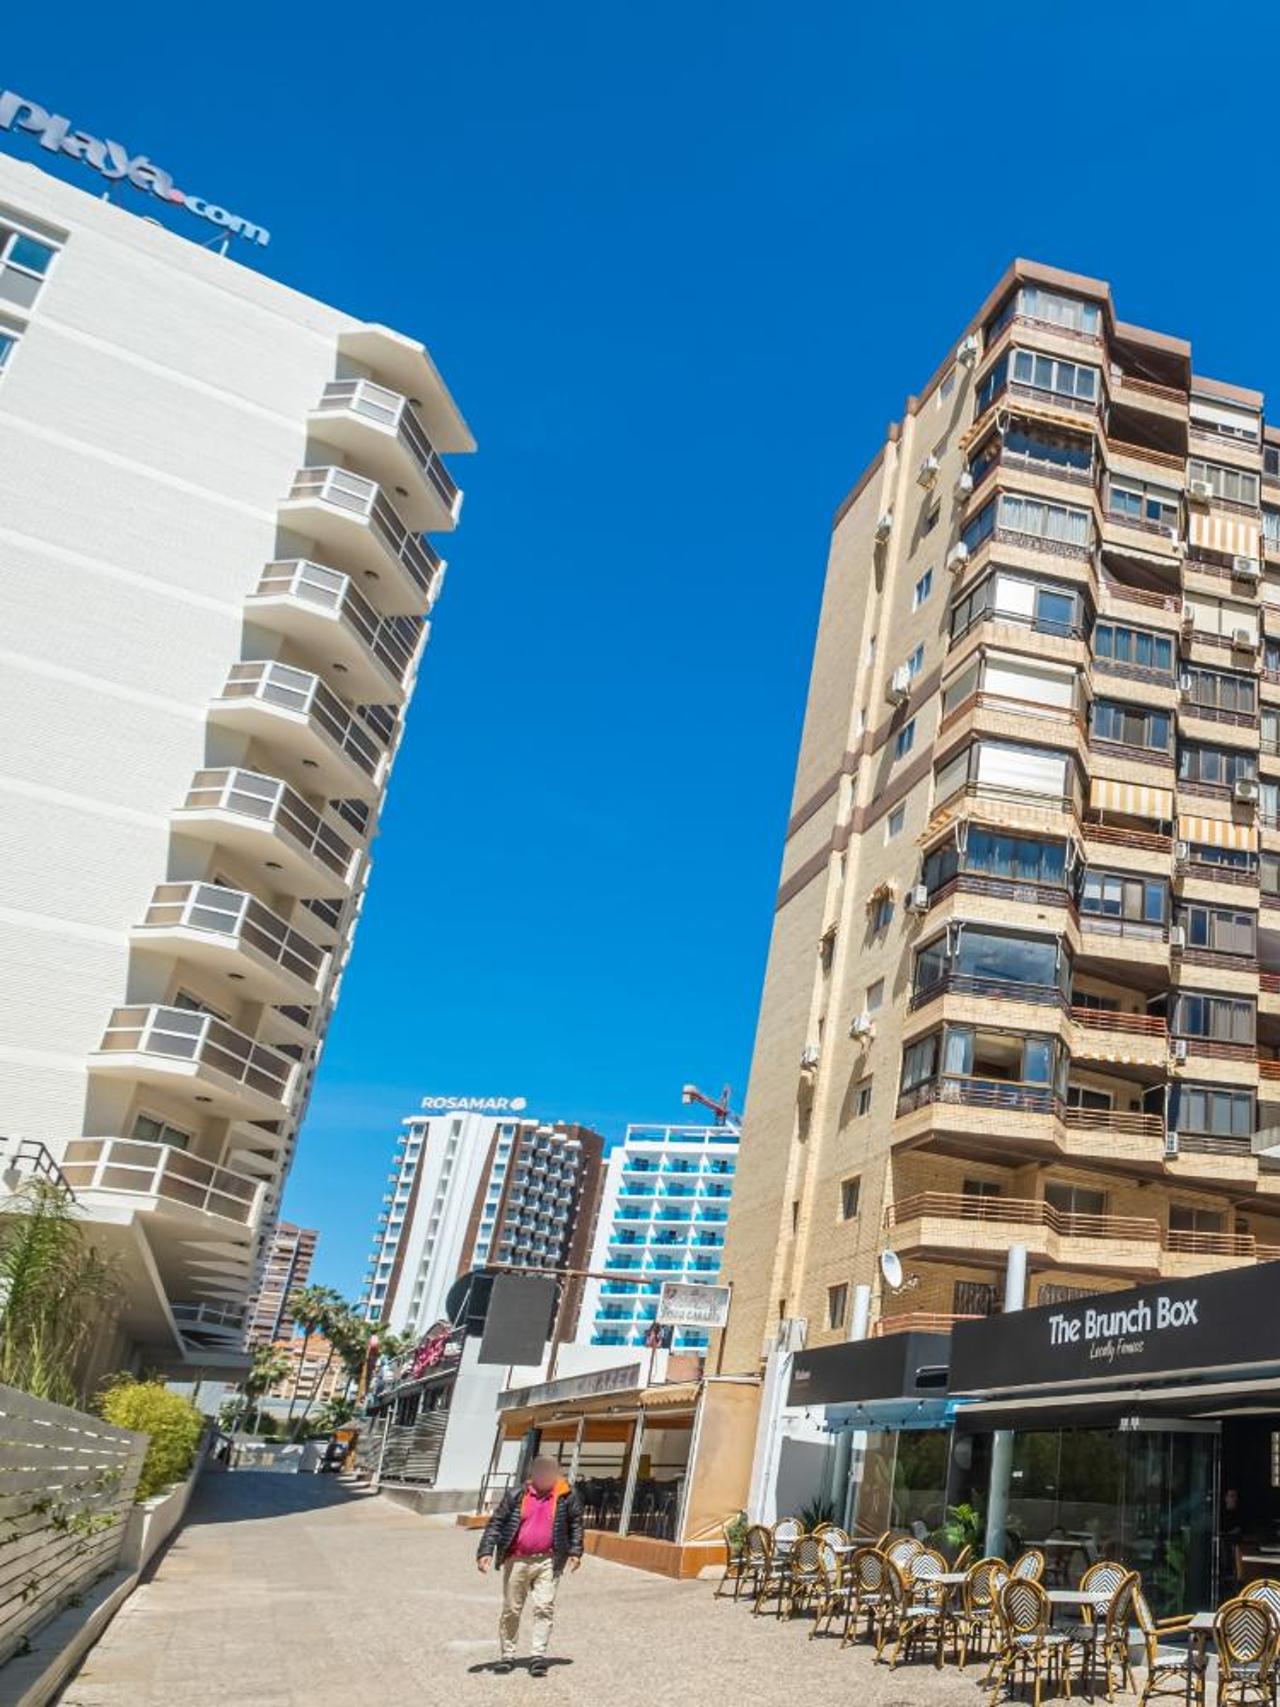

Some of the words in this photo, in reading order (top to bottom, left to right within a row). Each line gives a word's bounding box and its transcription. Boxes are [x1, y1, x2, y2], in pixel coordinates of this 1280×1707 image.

[421, 1096, 508, 1110] ROSAMAR
[1049, 1314, 1081, 1345] The
[1085, 1300, 1151, 1340] Brunch
[1157, 1296, 1199, 1329] Box
